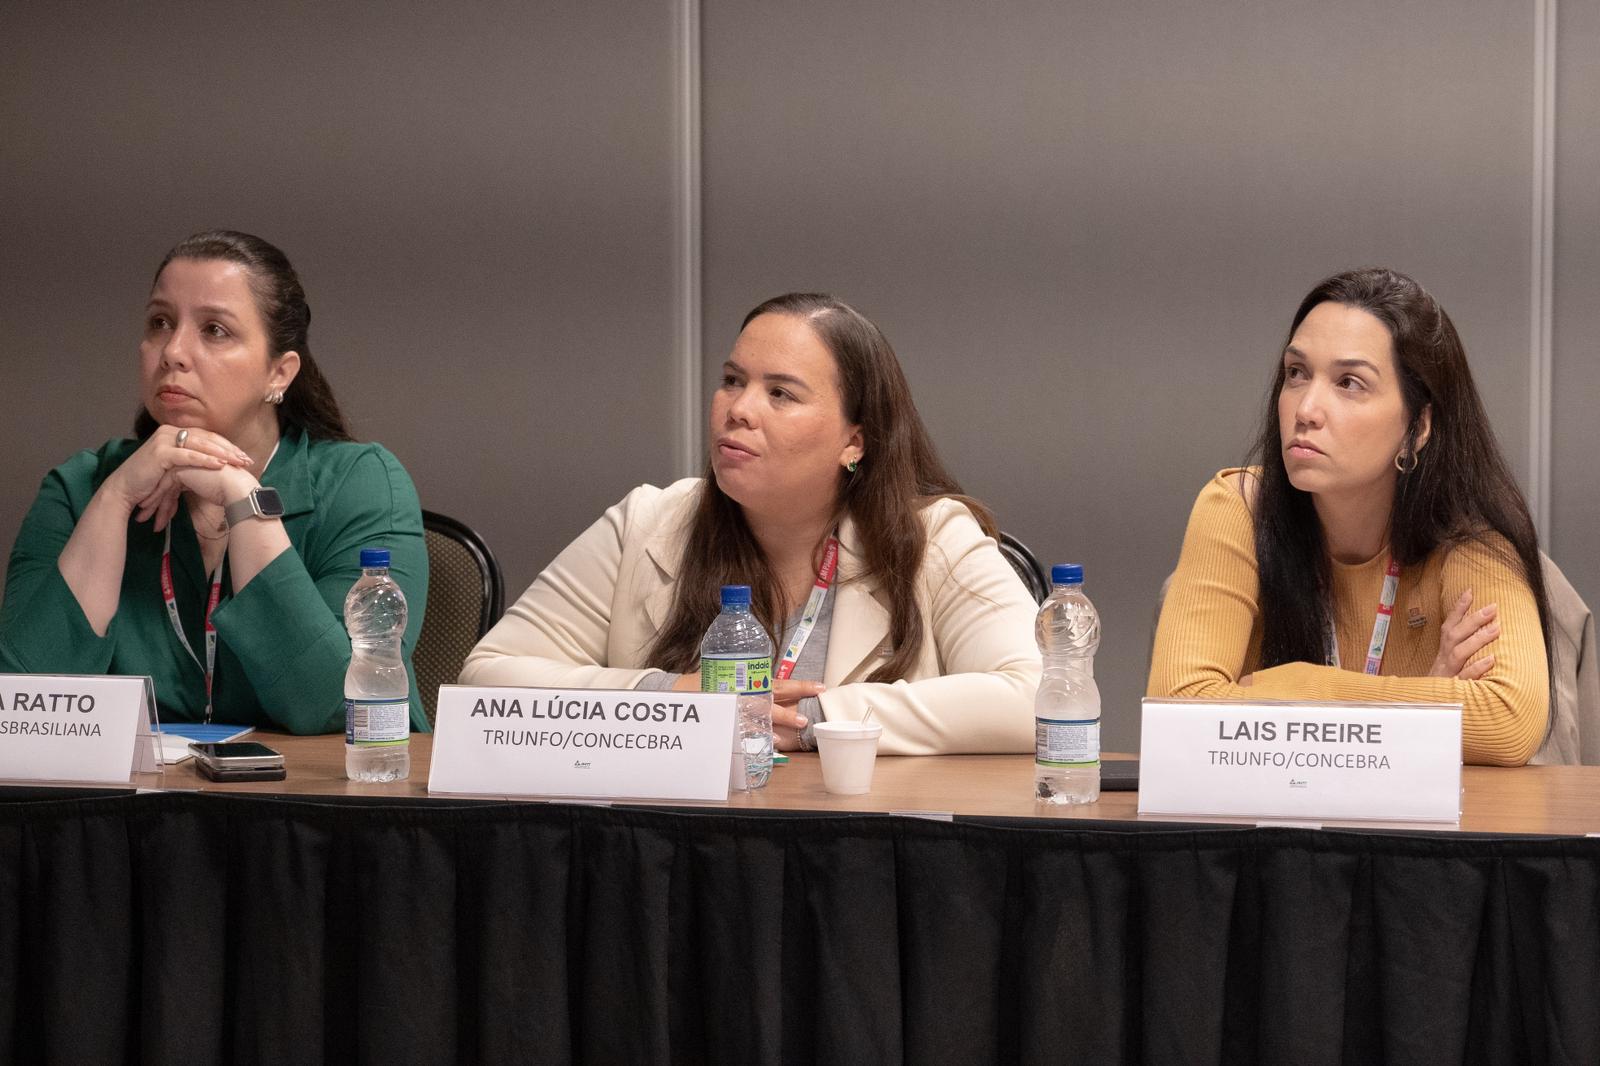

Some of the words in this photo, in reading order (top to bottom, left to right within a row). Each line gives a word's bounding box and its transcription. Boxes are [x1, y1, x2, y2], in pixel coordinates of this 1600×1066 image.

[13, 692, 96, 714] RATTO
[470, 698, 524, 719] ANA
[531, 695, 607, 721] LÚCIA
[614, 701, 701, 723] COSTA
[0, 720, 102, 737] SBRASILIANA
[1218, 720, 1277, 742] LAIS
[1286, 721, 1382, 744] FREIRE
[482, 729, 683, 750] TRIUNFO/CONCECBRA
[1207, 750, 1391, 770] TRIUNFO/CONCEBRA
